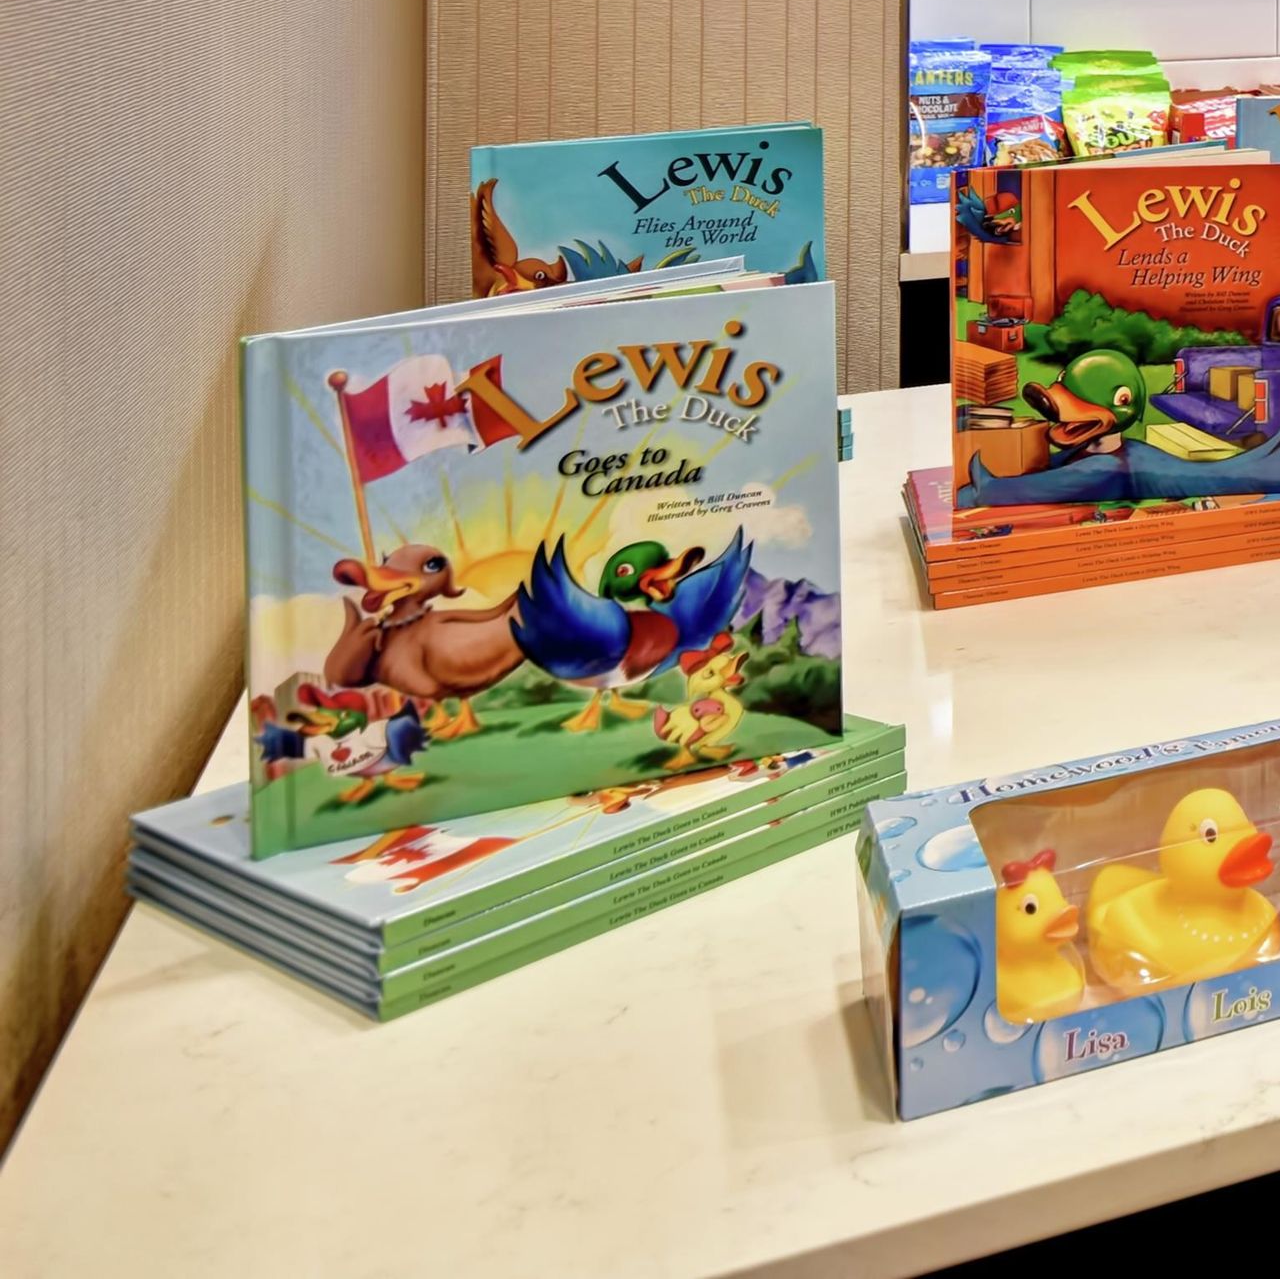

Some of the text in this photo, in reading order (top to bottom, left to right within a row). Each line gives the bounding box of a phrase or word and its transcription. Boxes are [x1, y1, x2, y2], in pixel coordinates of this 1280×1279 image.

[914, 70, 974, 86] ANTERS
[919, 96, 949, 104] NUTS &
[597, 141, 793, 214] Lewis
[684, 185, 780, 218] The Duck
[1068, 178, 1266, 251] Lewis
[632, 211, 755, 234] Flies Around
[665, 226, 757, 247] the World
[1155, 222, 1250, 258] The Duck
[1118, 248, 1188, 267] Lends a
[1131, 266, 1262, 289] Helping Wing
[454, 320, 782, 452] Lewis
[602, 395, 760, 443] The Duck
[558, 447, 667, 476] Goes to
[581, 461, 704, 497] Canada
[648, 509, 695, 522] Illustrated
[657, 501, 691, 510] Written
[707, 494, 724, 503] Bill
[727, 491, 762, 501] Duncan
[958, 739, 1189, 804] Homewood's
[1211, 988, 1273, 1022] Lois
[1065, 1028, 1130, 1063] Lisa
